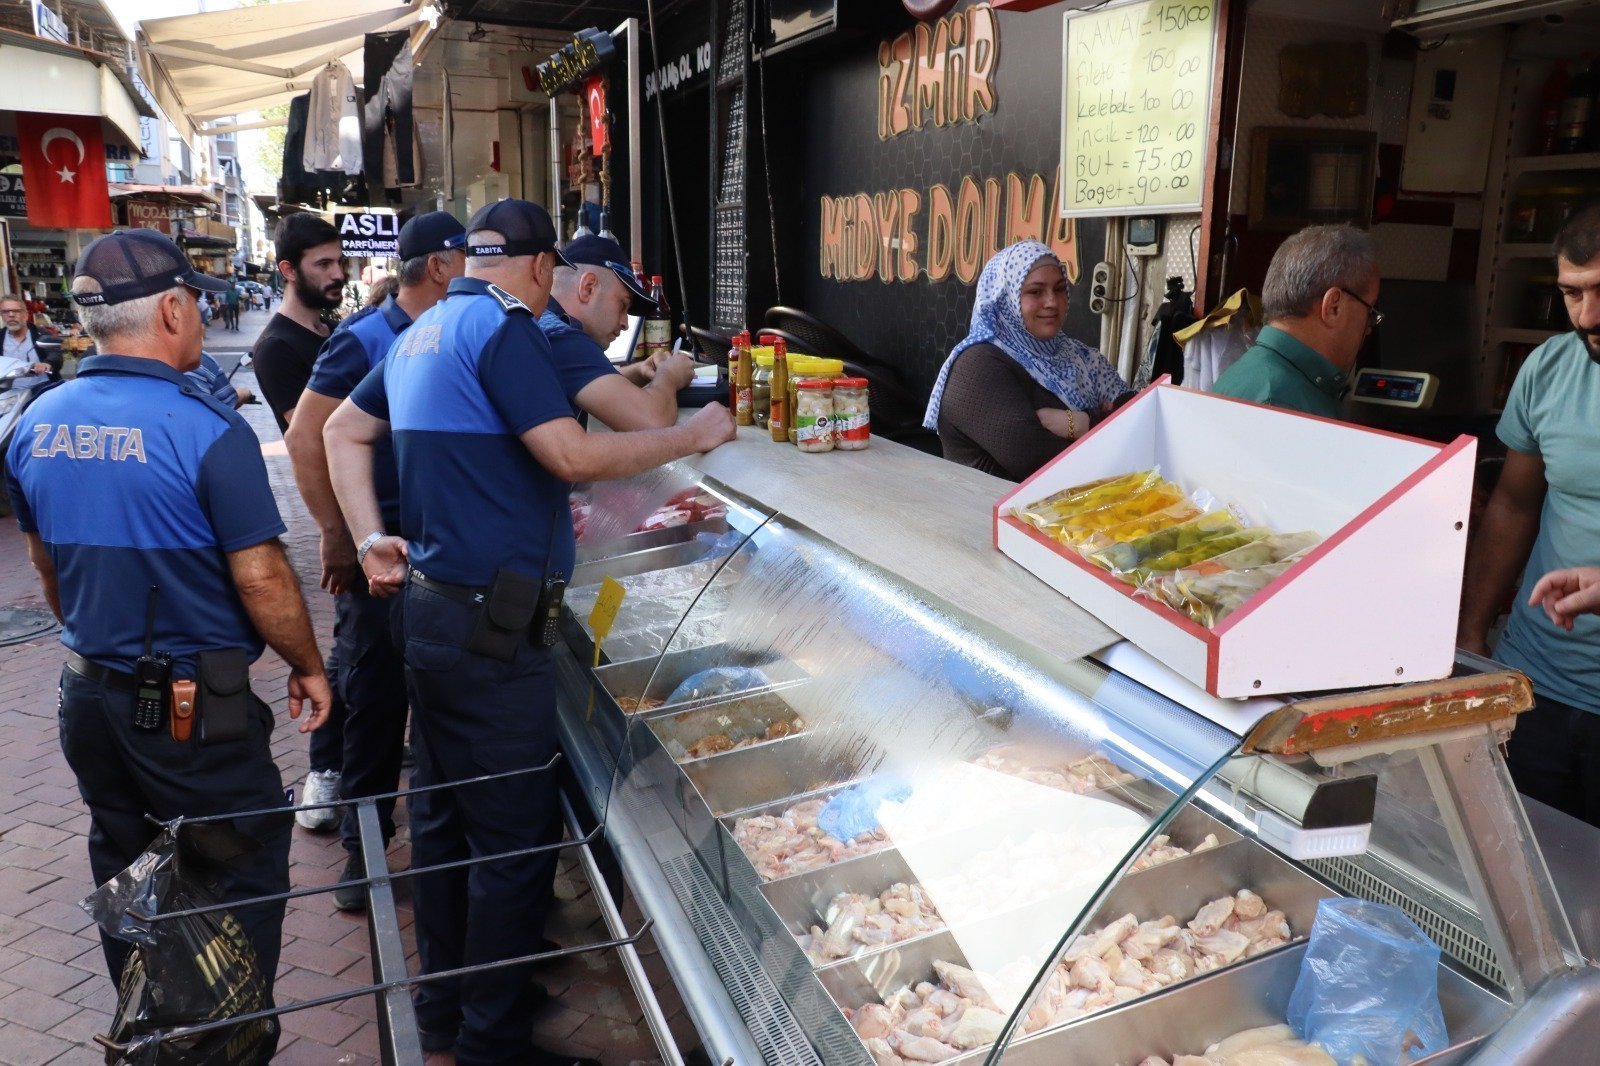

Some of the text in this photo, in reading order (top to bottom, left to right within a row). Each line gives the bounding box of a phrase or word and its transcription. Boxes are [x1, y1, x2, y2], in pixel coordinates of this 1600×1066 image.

[645, 52, 693, 102] ŞAAMPOL
[926, 163, 1081, 284] DOLMA
[32, 424, 147, 464] ZABITA
